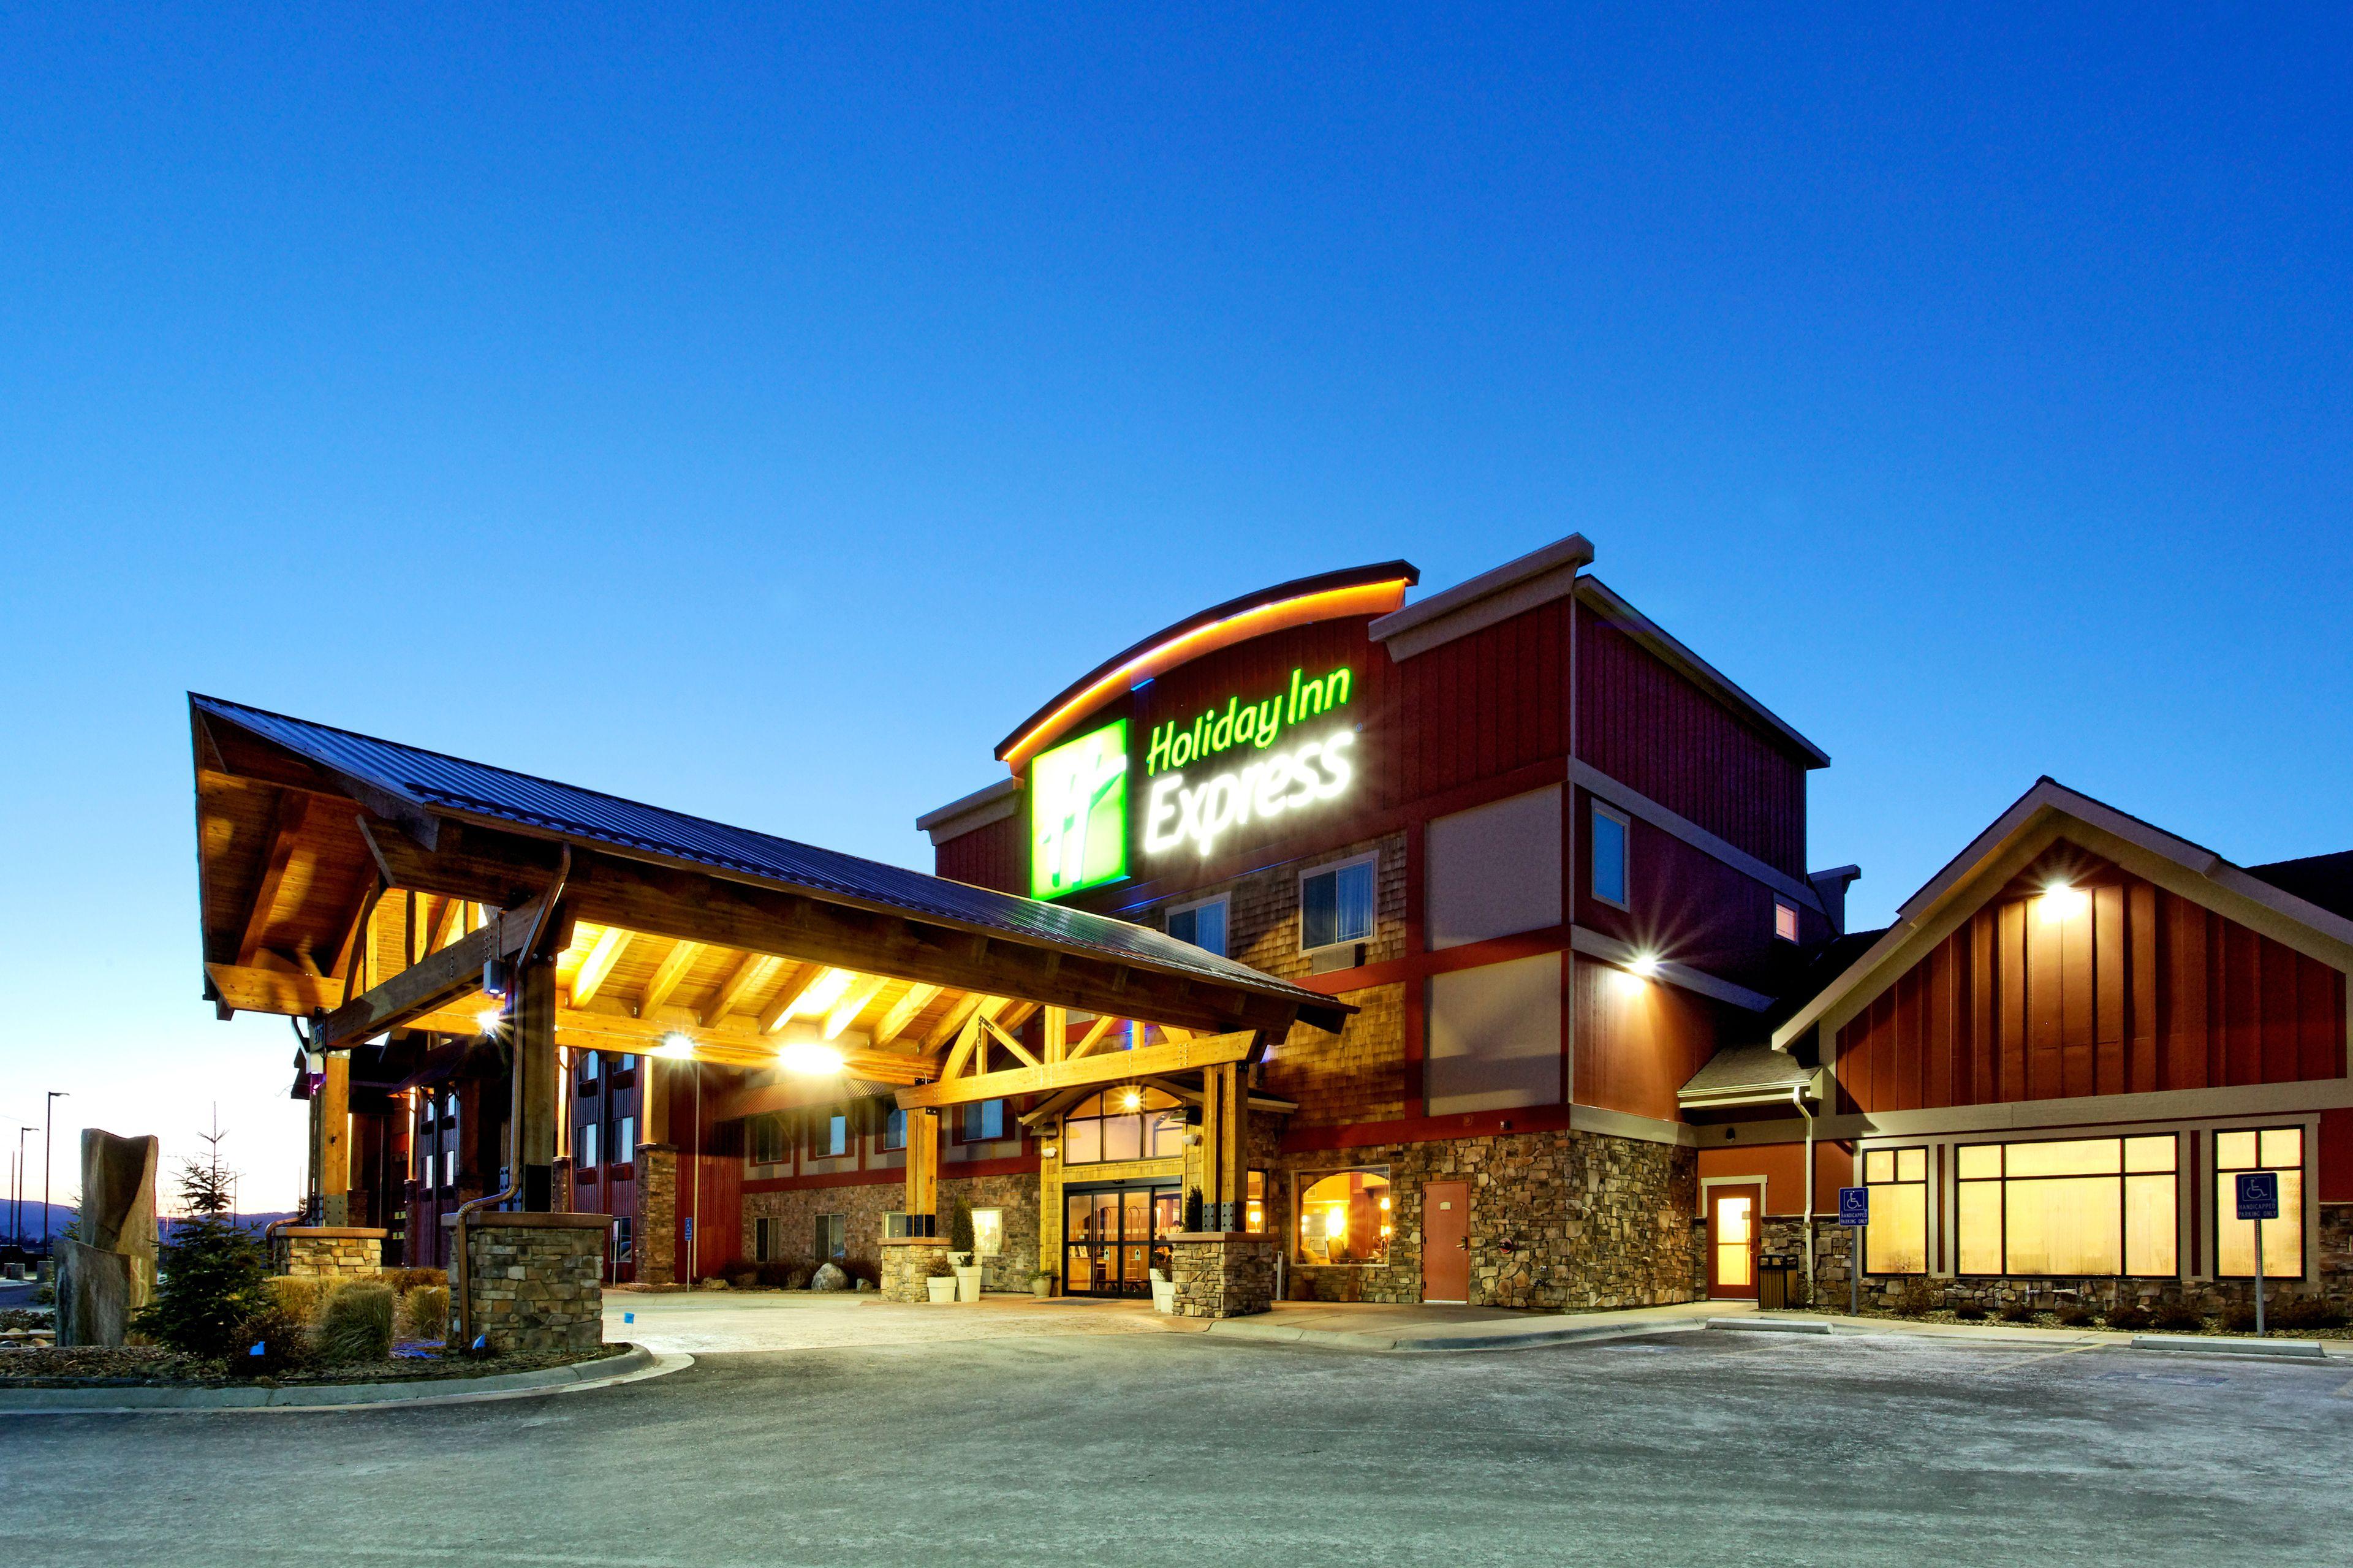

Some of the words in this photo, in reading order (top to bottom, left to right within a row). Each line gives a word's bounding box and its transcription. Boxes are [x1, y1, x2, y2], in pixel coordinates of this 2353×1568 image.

[1146, 694, 1283, 776] Holiday
[1287, 667, 1351, 725] Inn
[1144, 731, 1355, 855] Express
